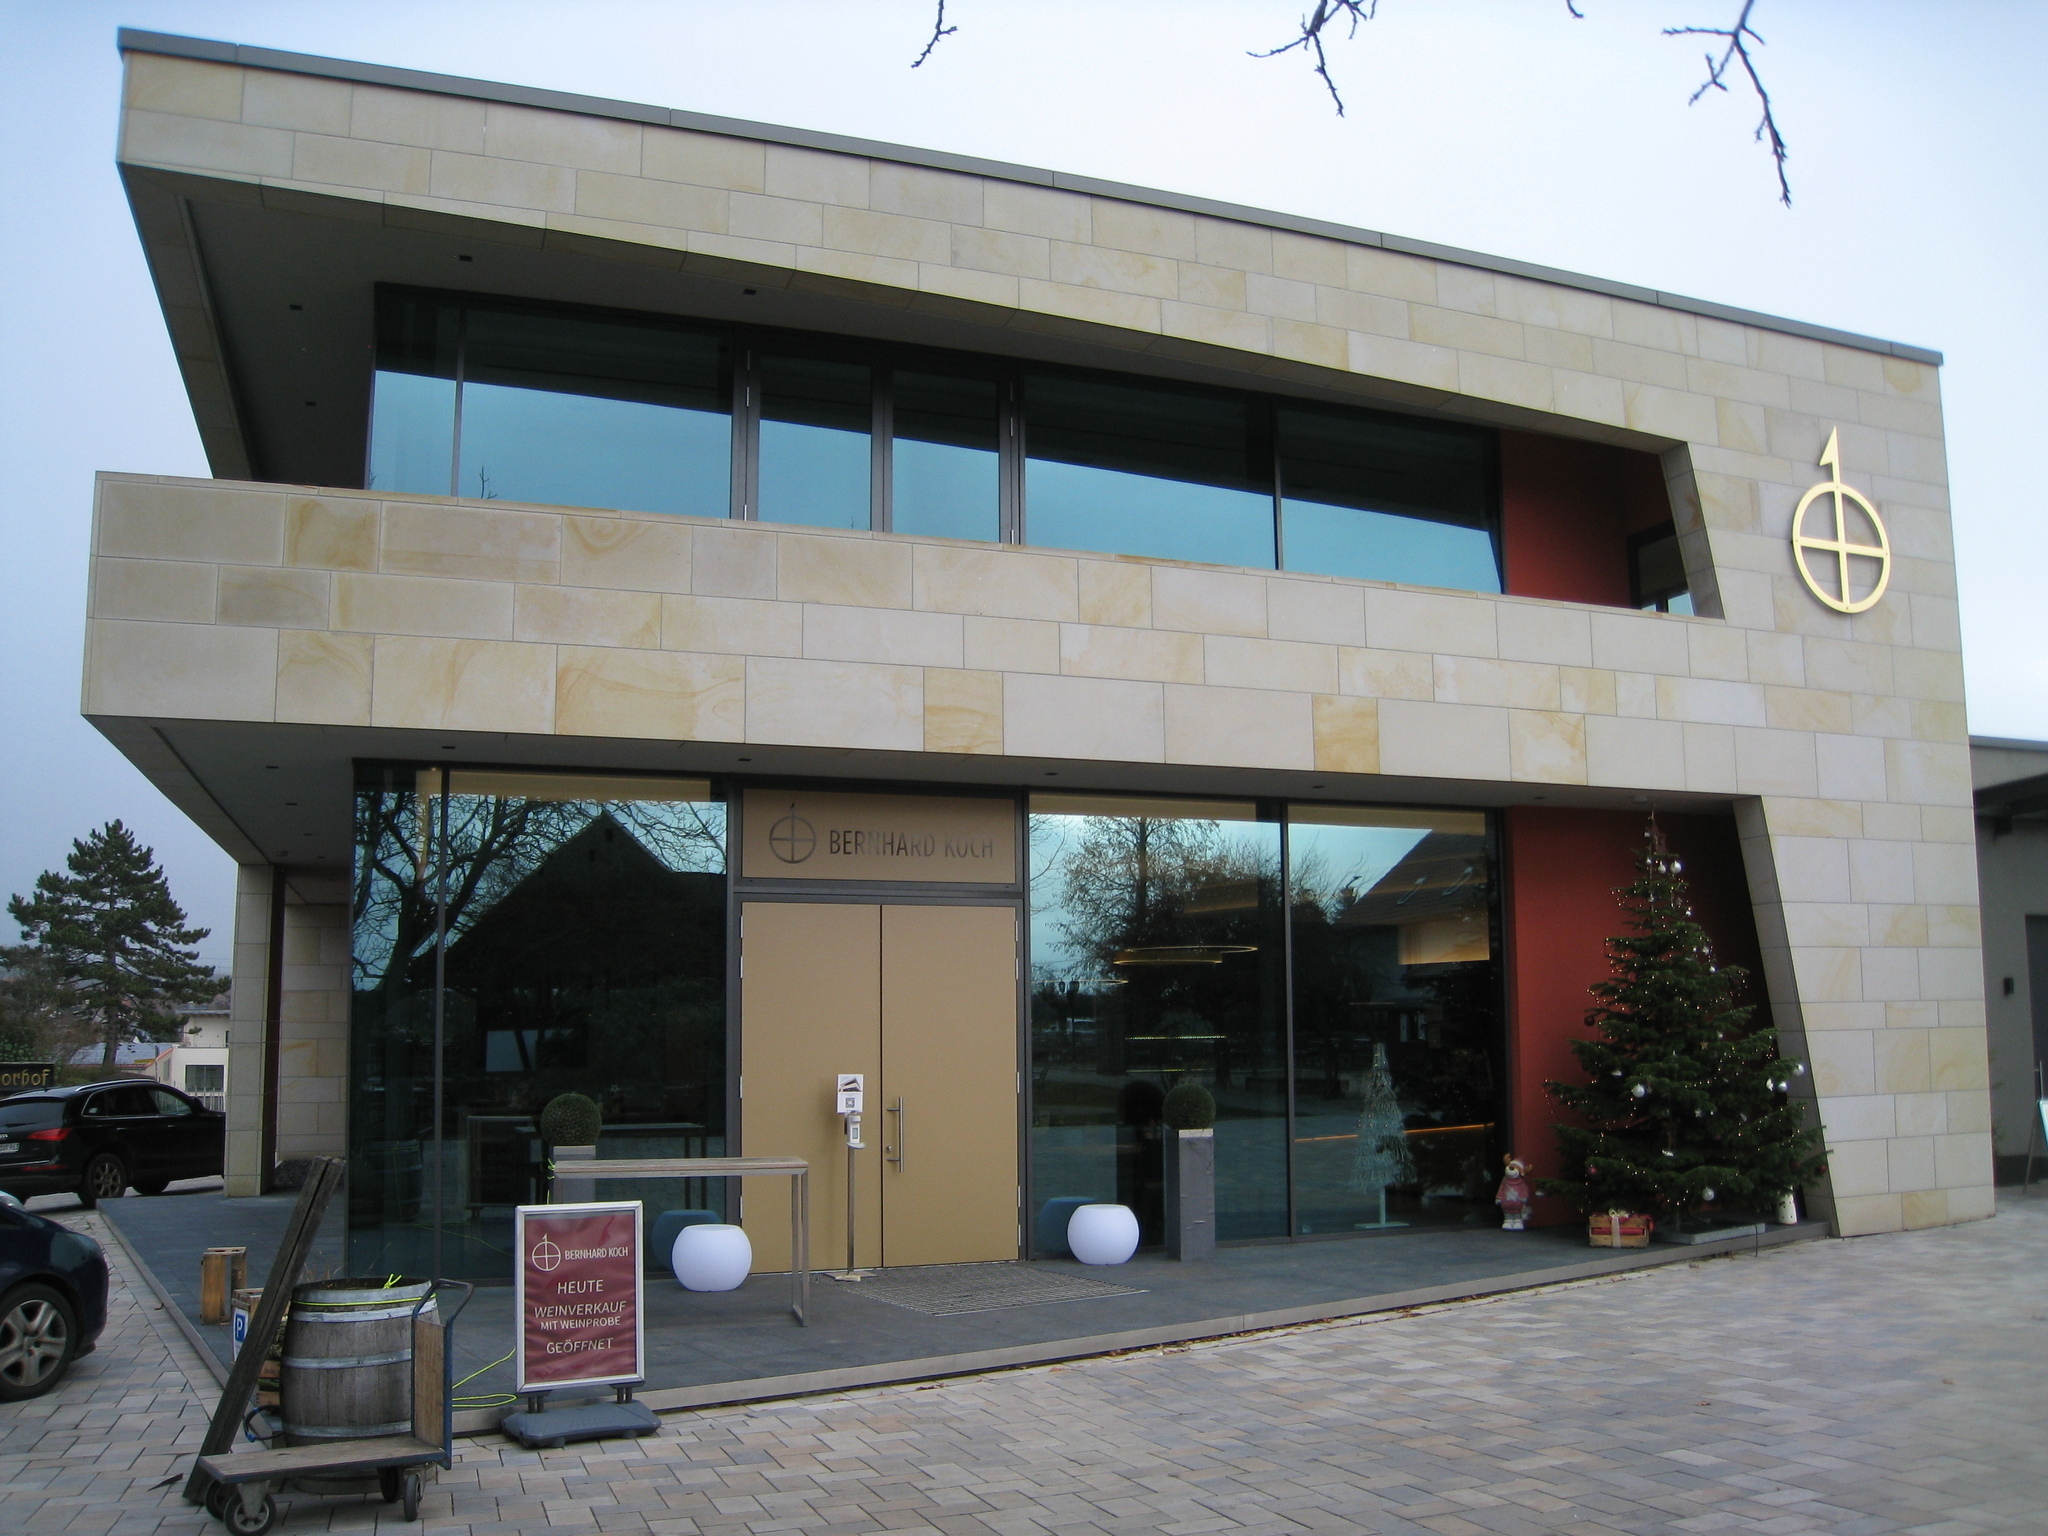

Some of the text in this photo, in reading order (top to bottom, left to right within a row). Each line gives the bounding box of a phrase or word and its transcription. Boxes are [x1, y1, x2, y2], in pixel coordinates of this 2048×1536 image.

[829, 830, 993, 858] BERNHARD KOCH
[564, 1246, 628, 1260] BERNHARD KOCH
[557, 1279, 604, 1294] HEUTE
[534, 1301, 627, 1318] WEINVERKAUF
[236, 1317, 243, 1338] P
[540, 1316, 621, 1330] MIT WEINPROBE
[546, 1337, 614, 1355] GEÖFFNET
